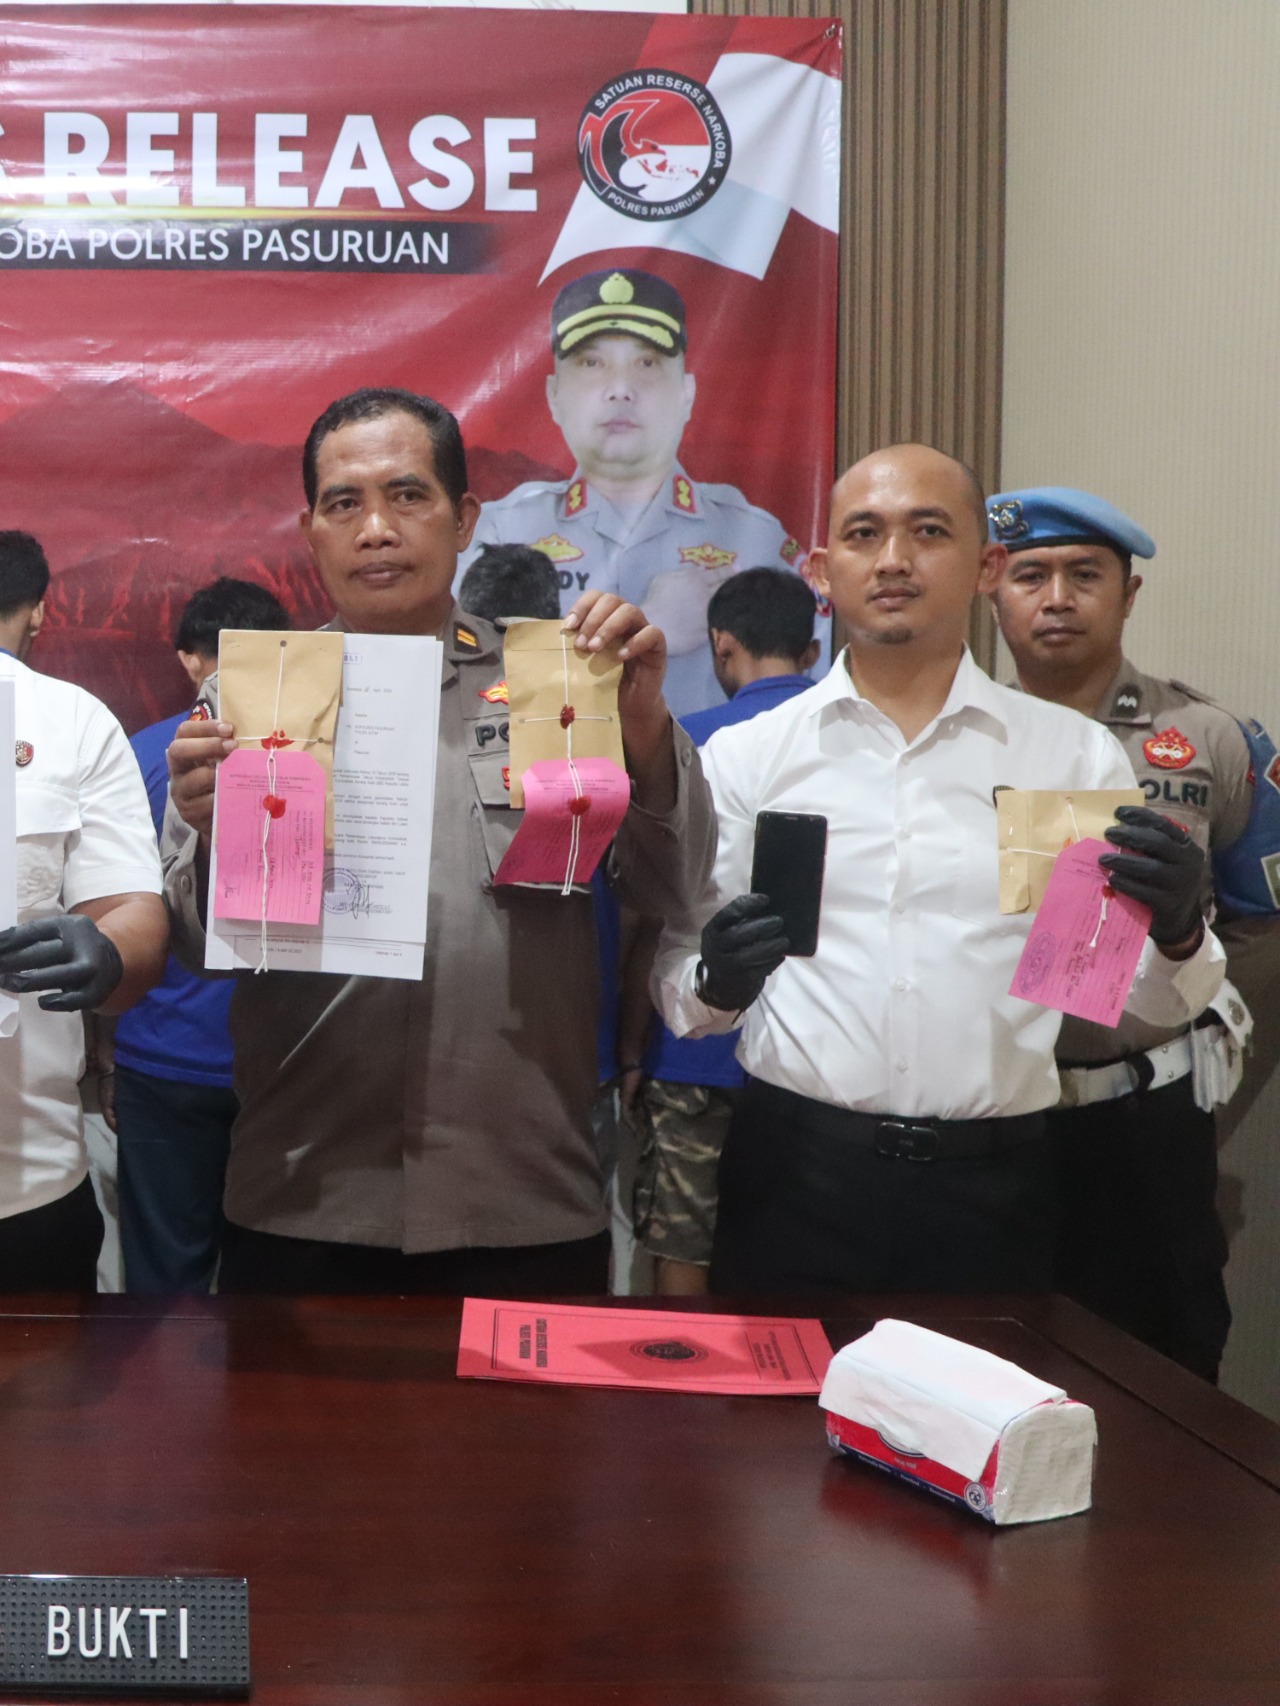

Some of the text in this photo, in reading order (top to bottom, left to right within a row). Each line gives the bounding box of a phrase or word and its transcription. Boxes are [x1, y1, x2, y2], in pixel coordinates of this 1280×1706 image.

[595, 75, 726, 168] SATUAN RESERSE NARKOBA
[44, 112, 537, 211] RELEASE
[607, 189, 704, 216] POLRES PASURUAN
[89, 228, 229, 261] POLRES
[242, 231, 448, 264] PASURUAN
[48, 1605, 188, 1659] BUKTI
